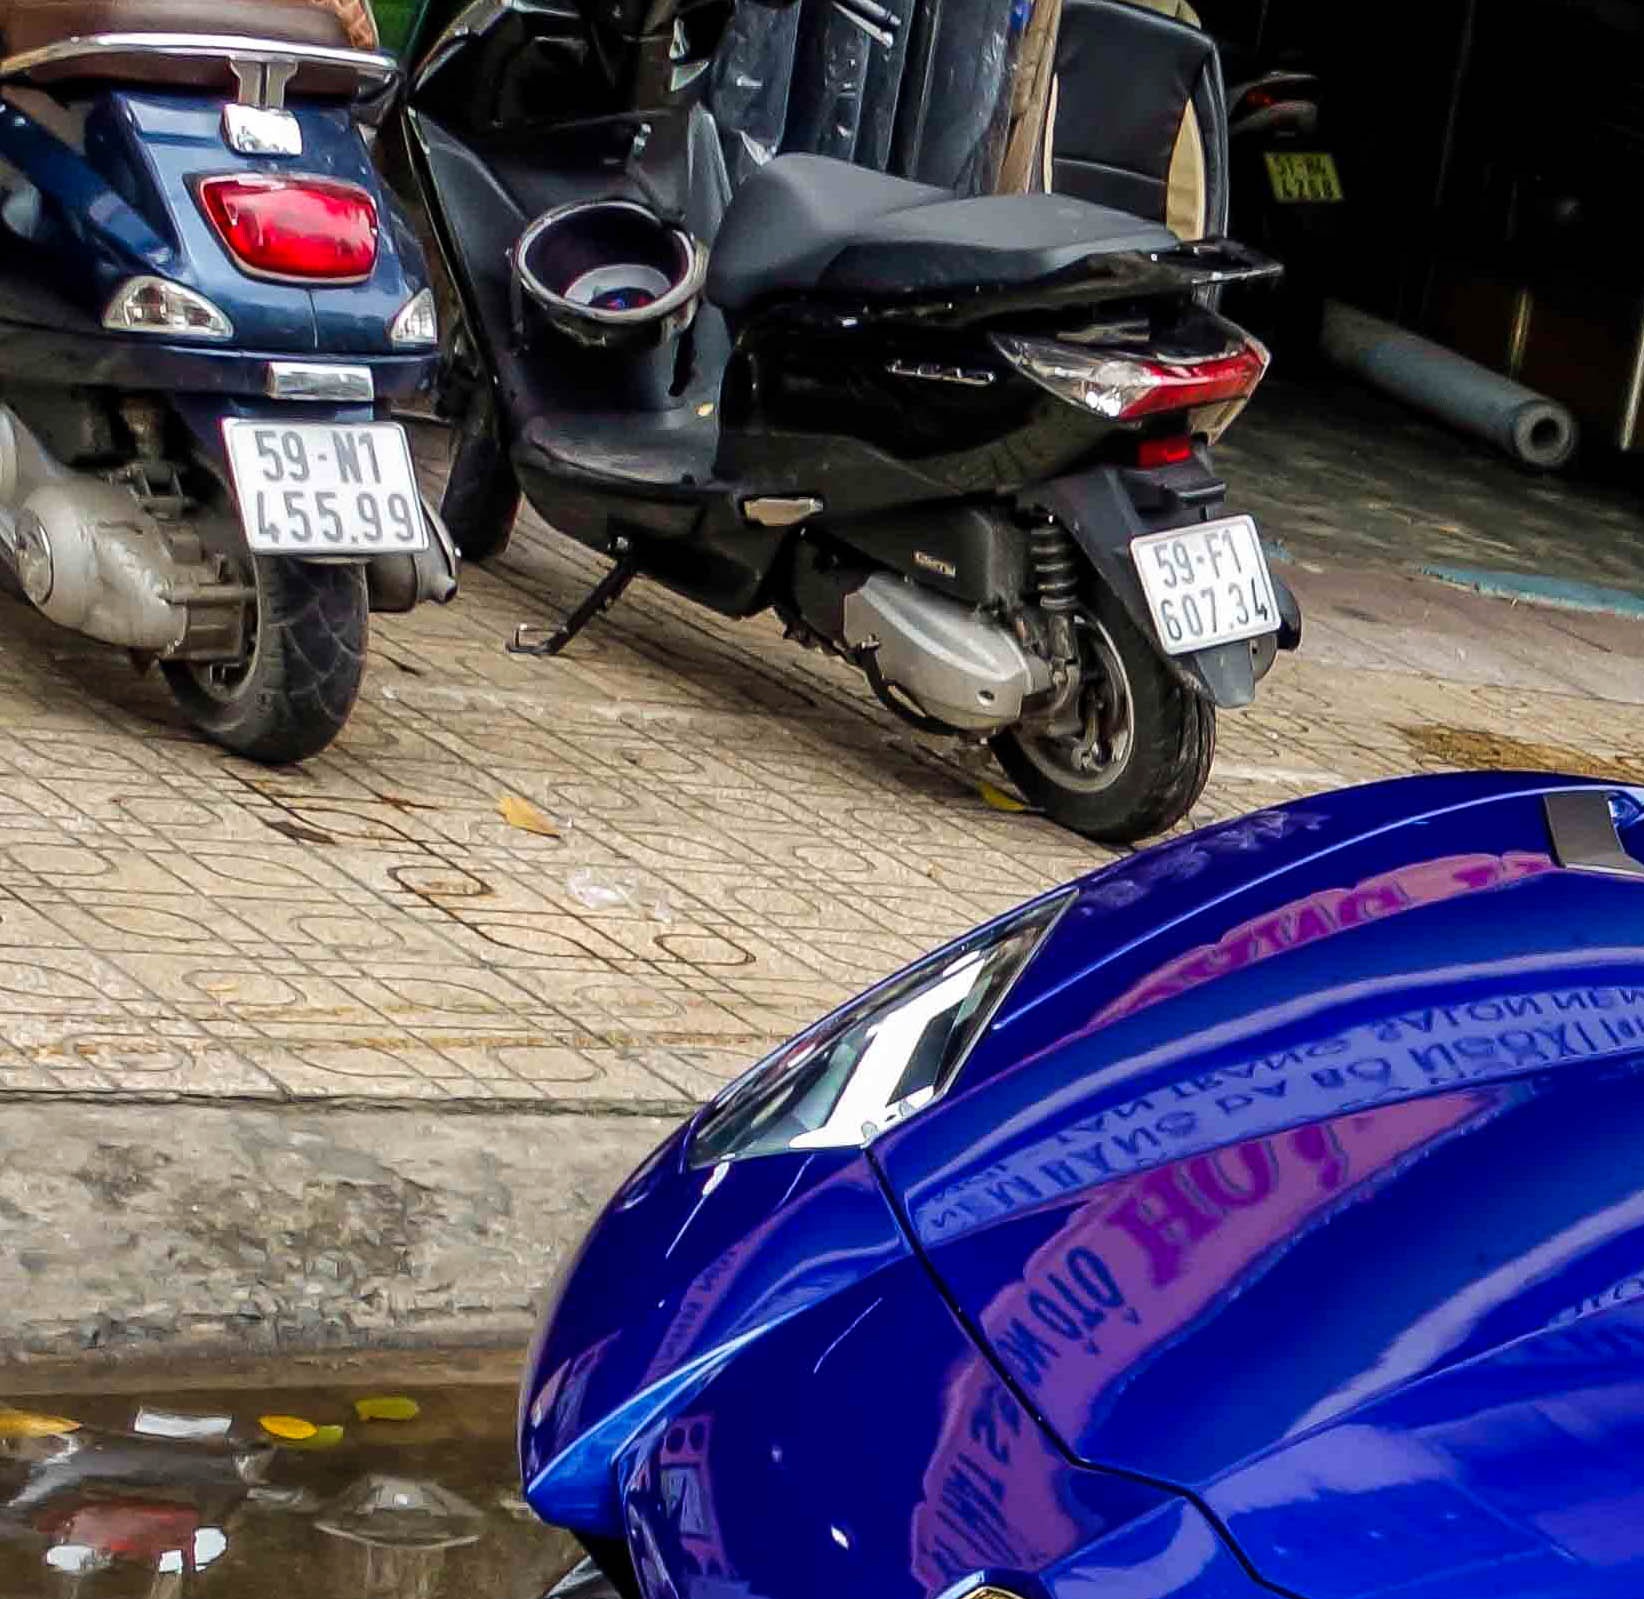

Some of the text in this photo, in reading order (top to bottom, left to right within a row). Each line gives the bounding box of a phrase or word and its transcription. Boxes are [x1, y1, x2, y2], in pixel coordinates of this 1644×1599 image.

[255, 430, 381, 484] 59-N1
[256, 491, 414, 544] 455.99
[1153, 529, 1241, 588] 59-F1
[1160, 577, 1268, 641] 607.34
